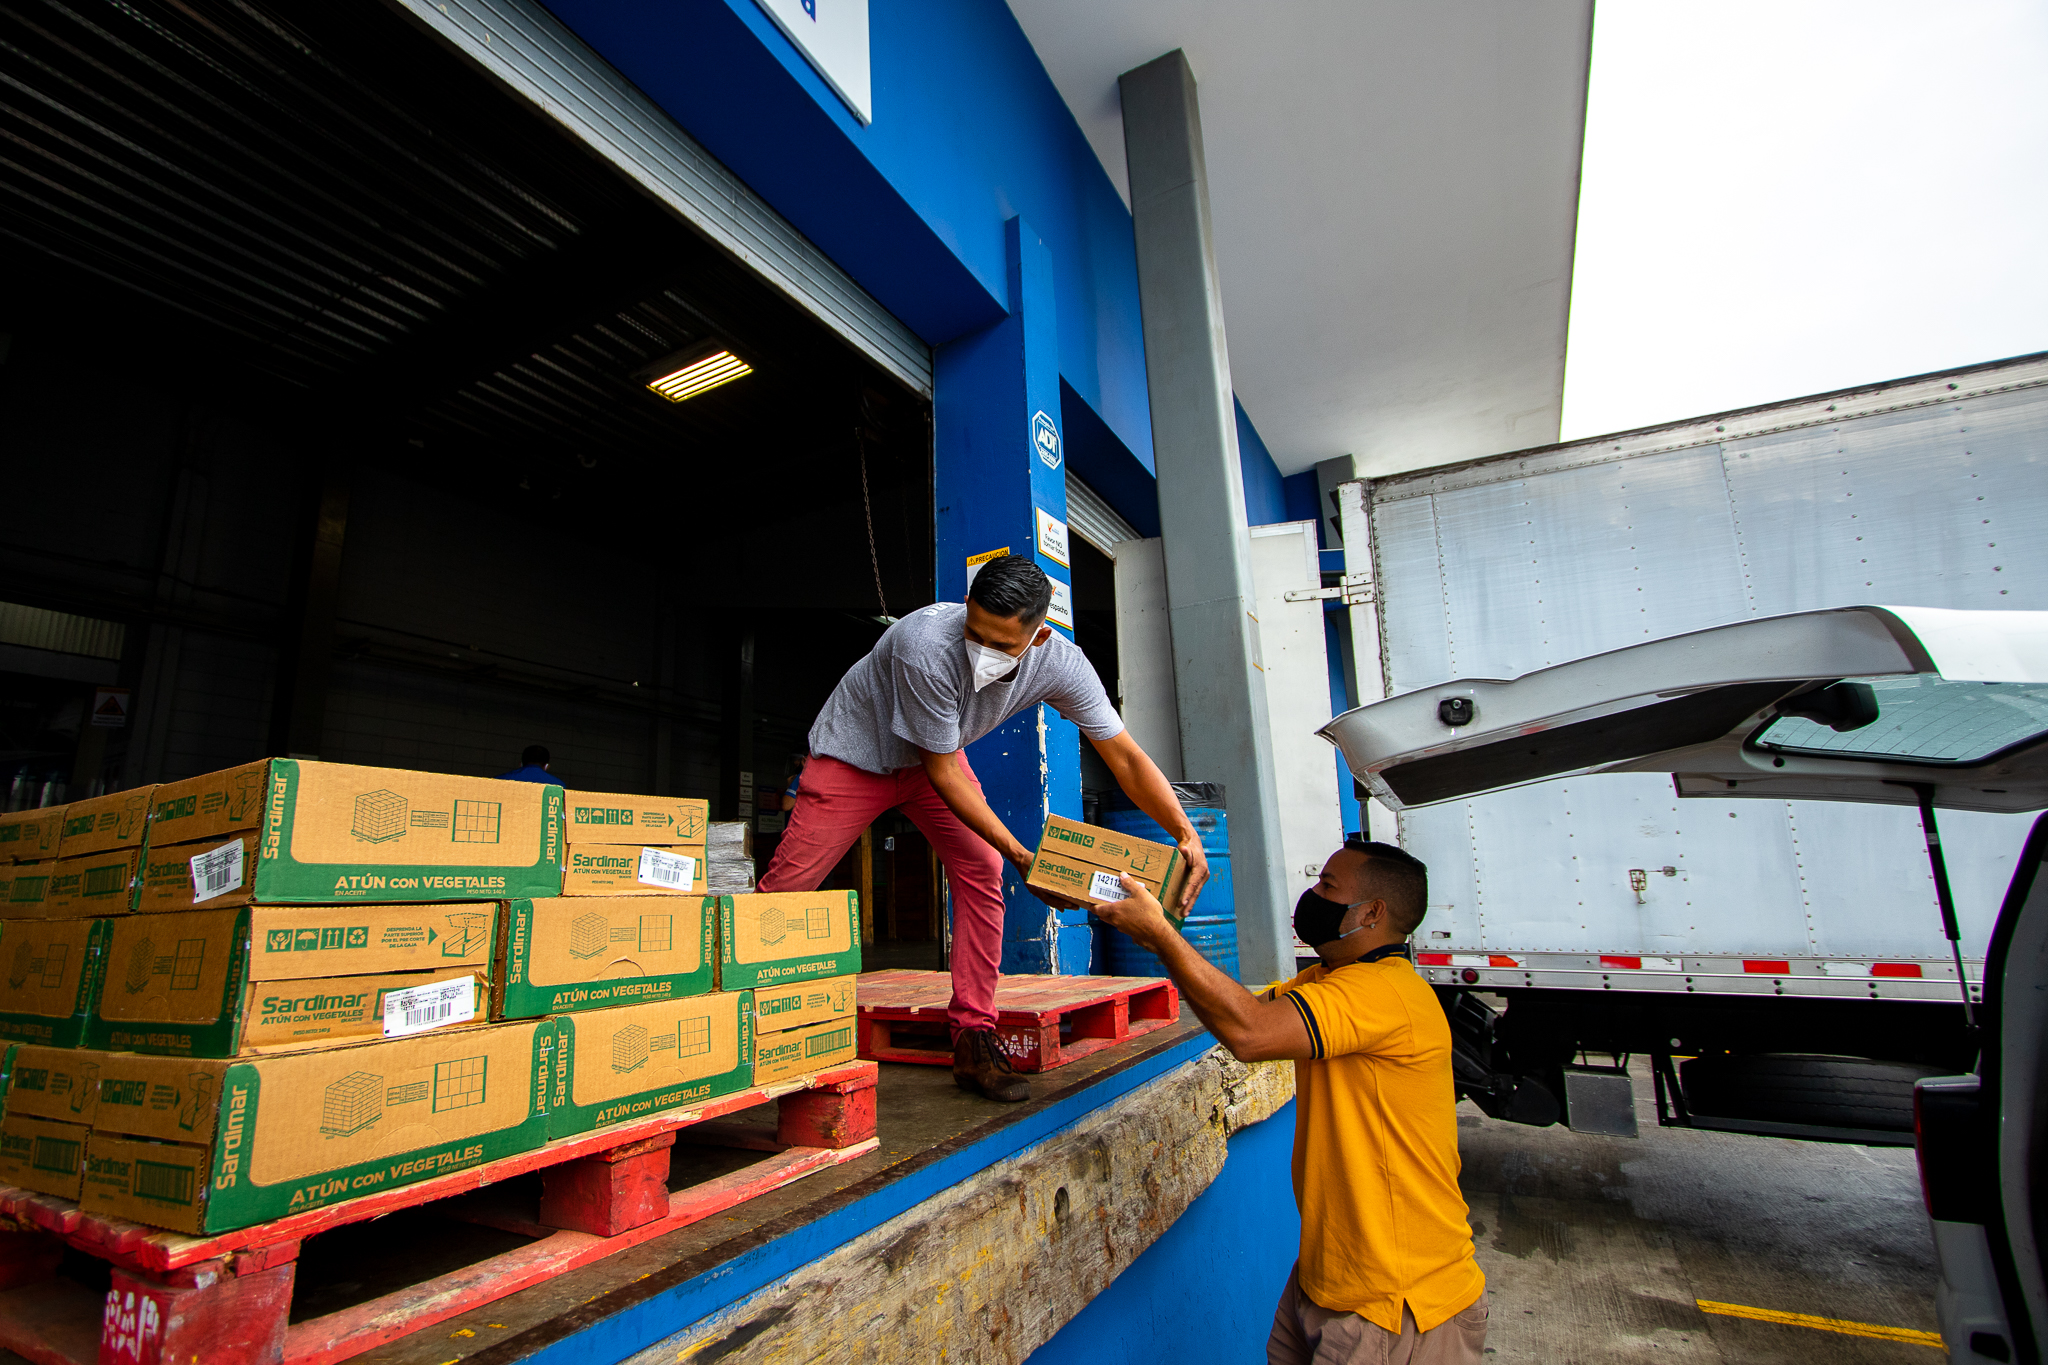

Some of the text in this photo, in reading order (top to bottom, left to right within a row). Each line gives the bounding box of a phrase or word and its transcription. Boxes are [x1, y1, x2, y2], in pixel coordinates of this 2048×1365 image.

[1037, 427, 1057, 454] ADT
[1055, 540, 1063, 549] NO
[1049, 602, 1068, 615] espacho
[262, 772, 288, 860] Sardimar
[546, 796, 560, 864] Sardimar
[573, 854, 633, 868] Sardimar
[1039, 859, 1086, 879] Sardimar
[334, 873, 506, 889] ATÚN CON VEGETALES
[704, 906, 714, 966] Sardimar
[723, 905, 731, 964] Sardimar
[850, 898, 859, 948] Sardimar
[510, 909, 526, 984] Sardimar
[757, 960, 836, 980] ATÚN CON VEGETALES
[261, 993, 367, 1015] Sardimar
[552, 981, 672, 1004] ATÚN CON VEGETALES
[261, 1009, 364, 1025] ATÚN CON VEGETALES
[759, 1042, 802, 1061] Sardimar
[536, 1035, 552, 1114] Sardimar
[553, 1031, 568, 1107] Sardimar
[596, 1084, 710, 1122] ATÚN CON VEGETALES
[216, 1085, 248, 1190] Sardimar
[289, 1144, 483, 1205] ATÚN CON VEGETALES
